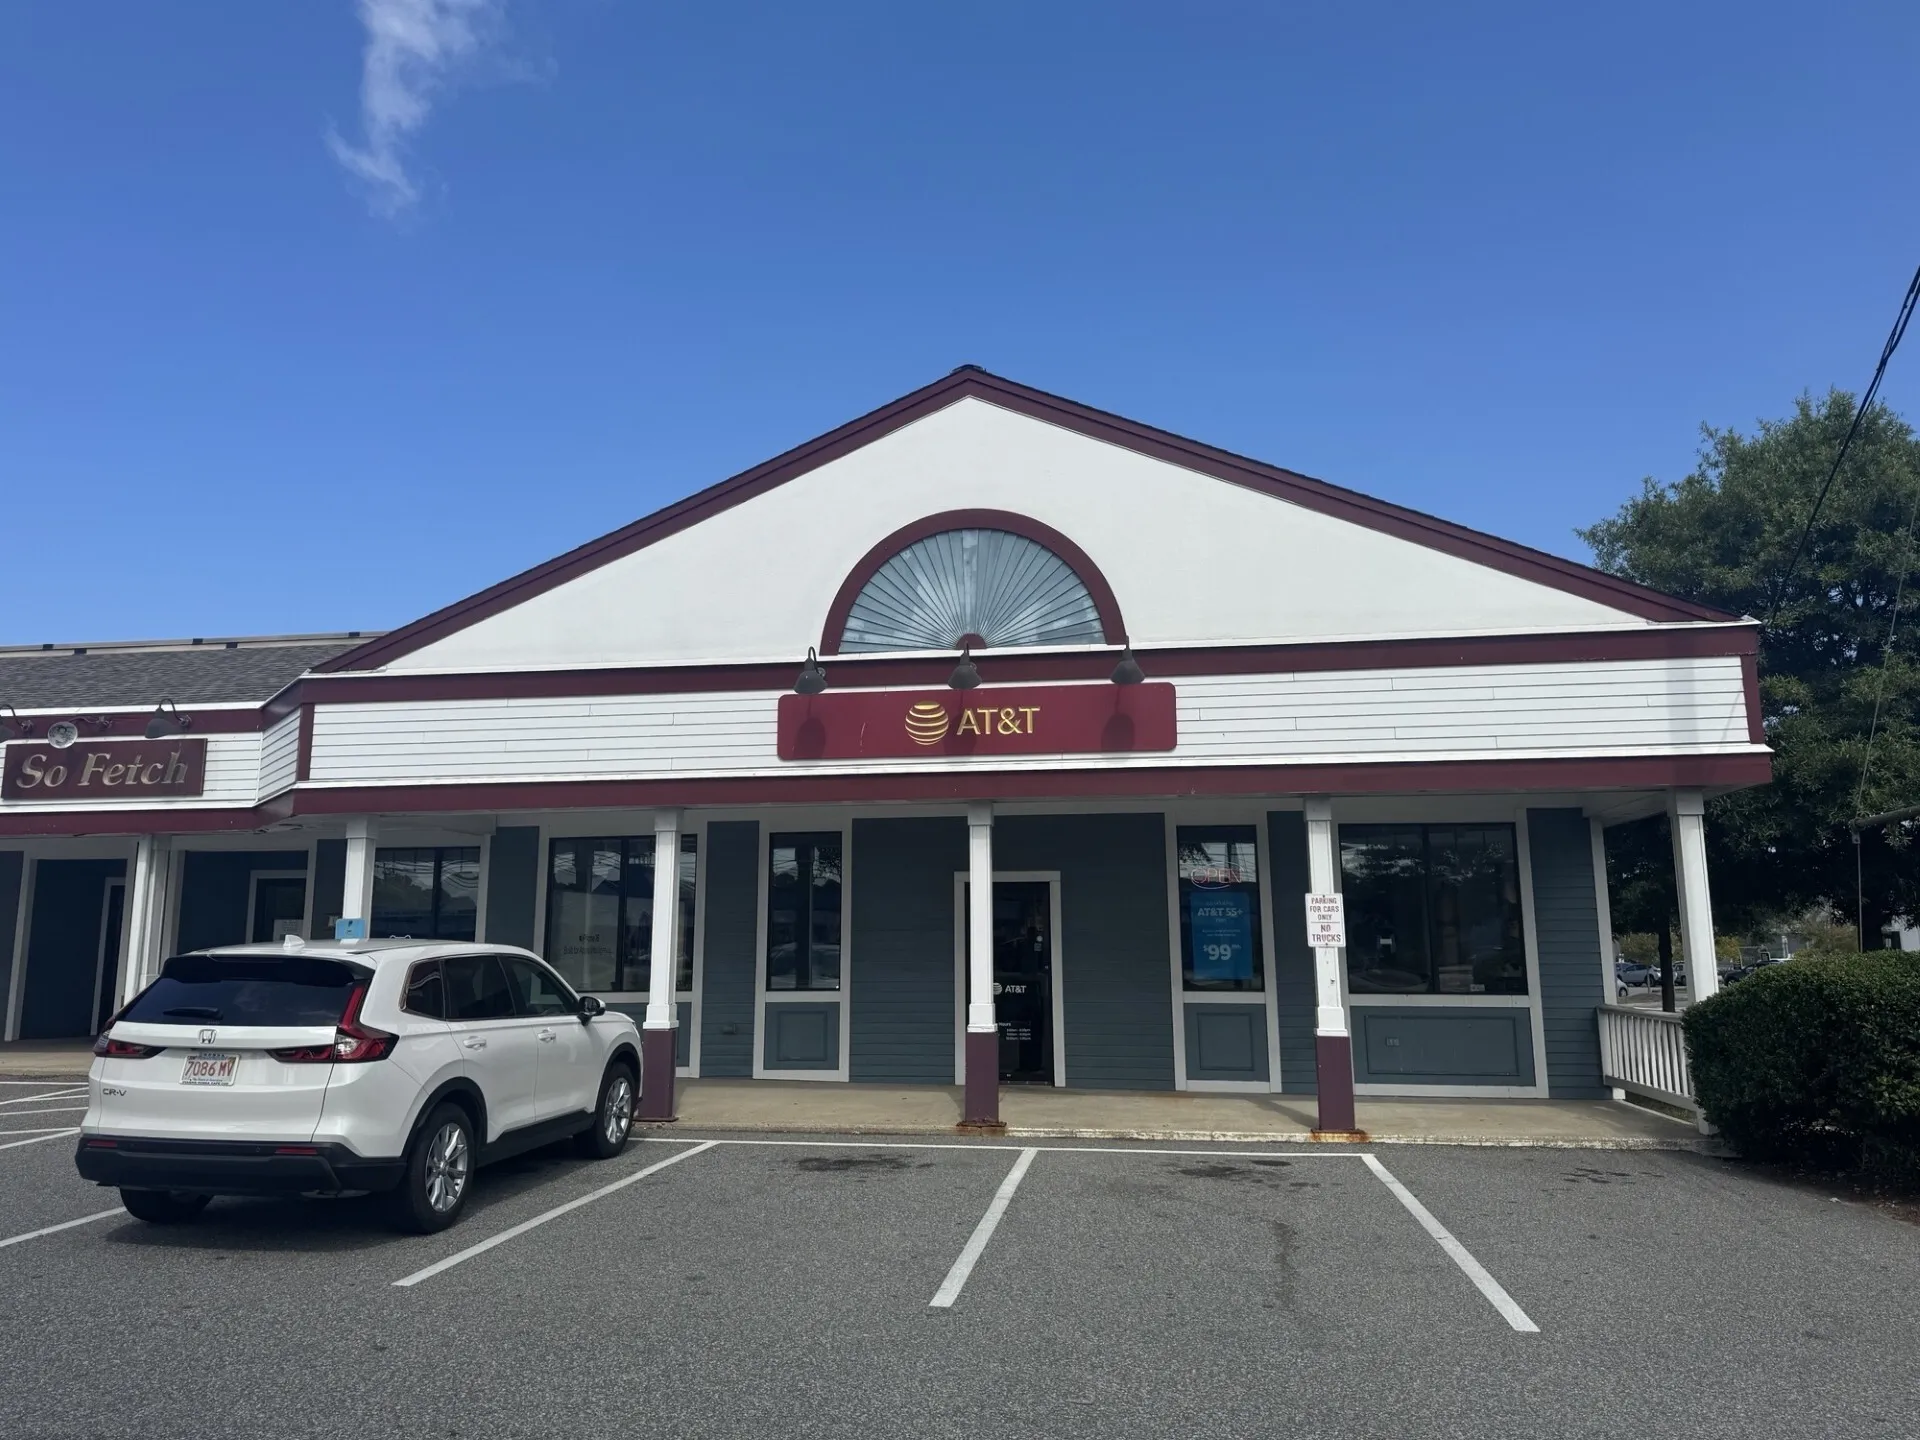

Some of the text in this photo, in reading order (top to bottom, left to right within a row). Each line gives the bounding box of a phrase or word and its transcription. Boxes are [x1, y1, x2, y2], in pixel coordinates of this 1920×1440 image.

[956, 706, 1041, 736] AT&T
[16, 751, 189, 789] So Fetch
[1191, 867, 1242, 883] OPEN
[1197, 907, 1244, 918] AT&T 55+
[1310, 905, 1321, 913] FOR
[1320, 924, 1331, 932] NO
[1312, 933, 1341, 943] TRUCKS
[1203, 943, 1232, 961] $99
[1005, 985, 1027, 994] AT&T
[184, 1061, 233, 1077] 7086 MV
